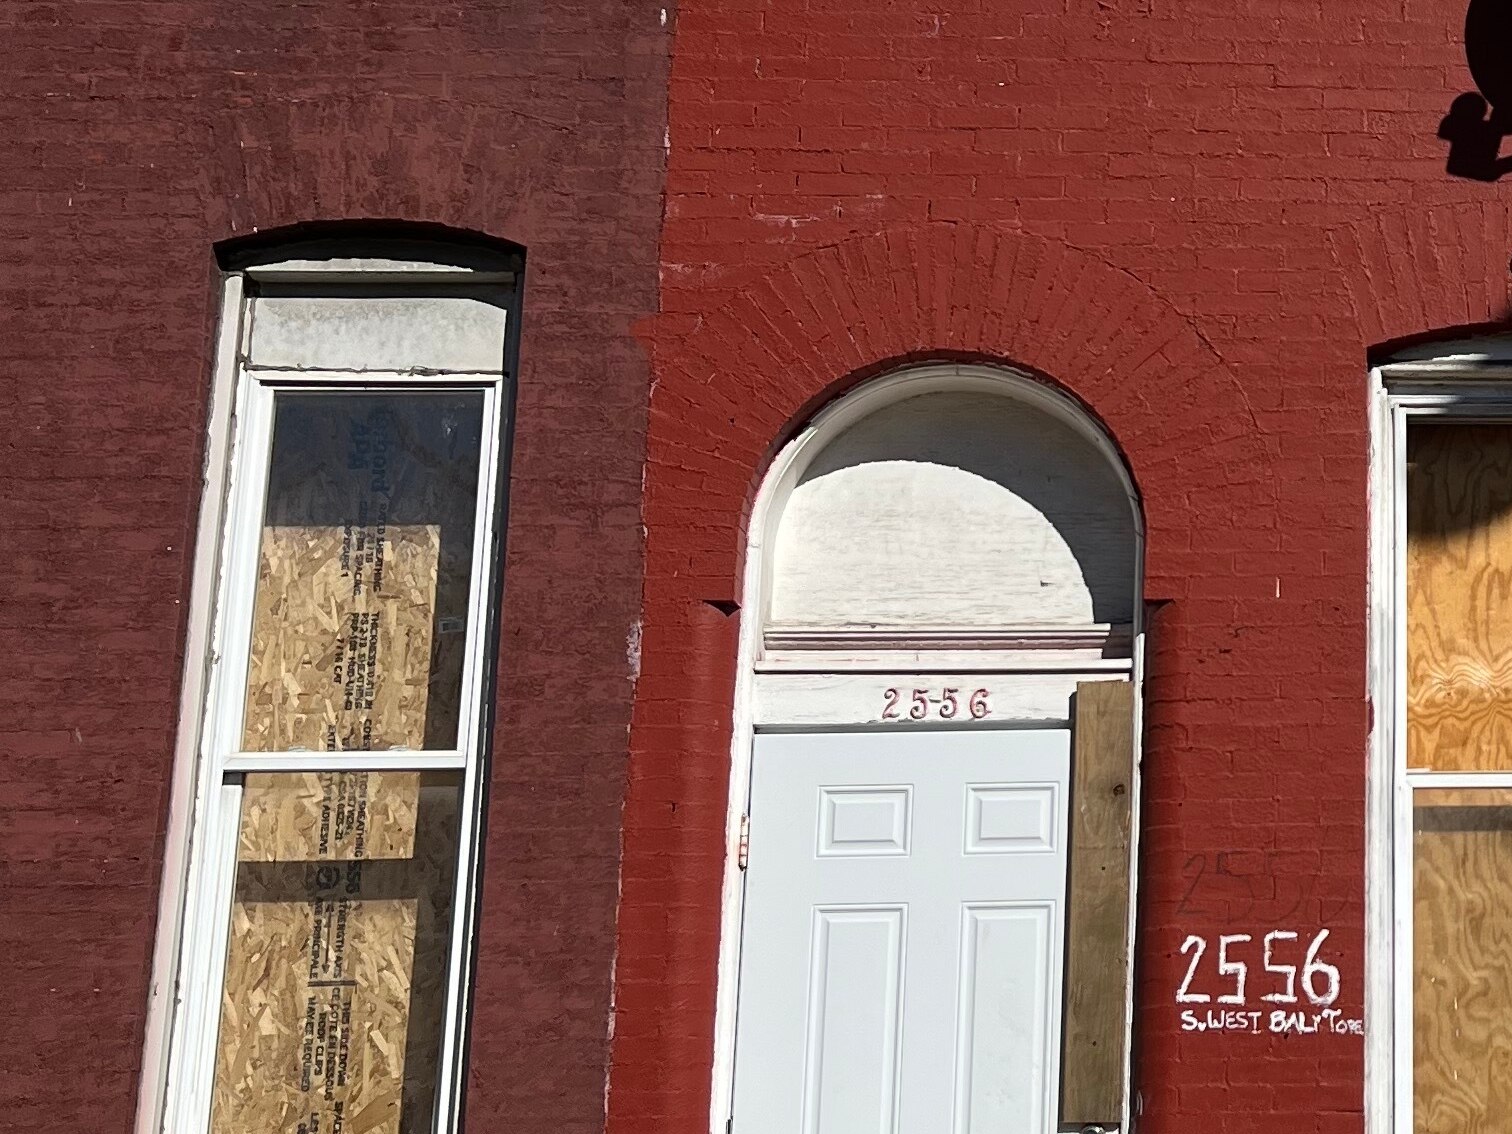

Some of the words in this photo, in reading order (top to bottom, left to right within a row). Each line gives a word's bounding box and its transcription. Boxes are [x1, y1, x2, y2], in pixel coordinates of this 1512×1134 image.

[353, 554, 364, 596] SPACING
[373, 537, 385, 593] SHEATHING
[367, 612, 380, 667] THICKNESS
[333, 665, 343, 684] CAT
[355, 653, 366, 709] SHEATHING
[881, 687, 992, 719] 2556
[319, 804, 331, 855] ADHESIVE
[355, 800, 367, 858] SHEATHING
[309, 919, 323, 980] PRINCIPALE
[334, 896, 349, 952] STRENGTH
[333, 955, 344, 980] AXIS
[1176, 928, 1341, 1006] 2556
[340, 1027, 350, 1051] SIDE
[301, 1039, 314, 1092] REQUIRED
[324, 1052, 336, 1101] DESSOUS
[337, 1053, 348, 1086] DOWN
[333, 1101, 344, 1134] SPACE
